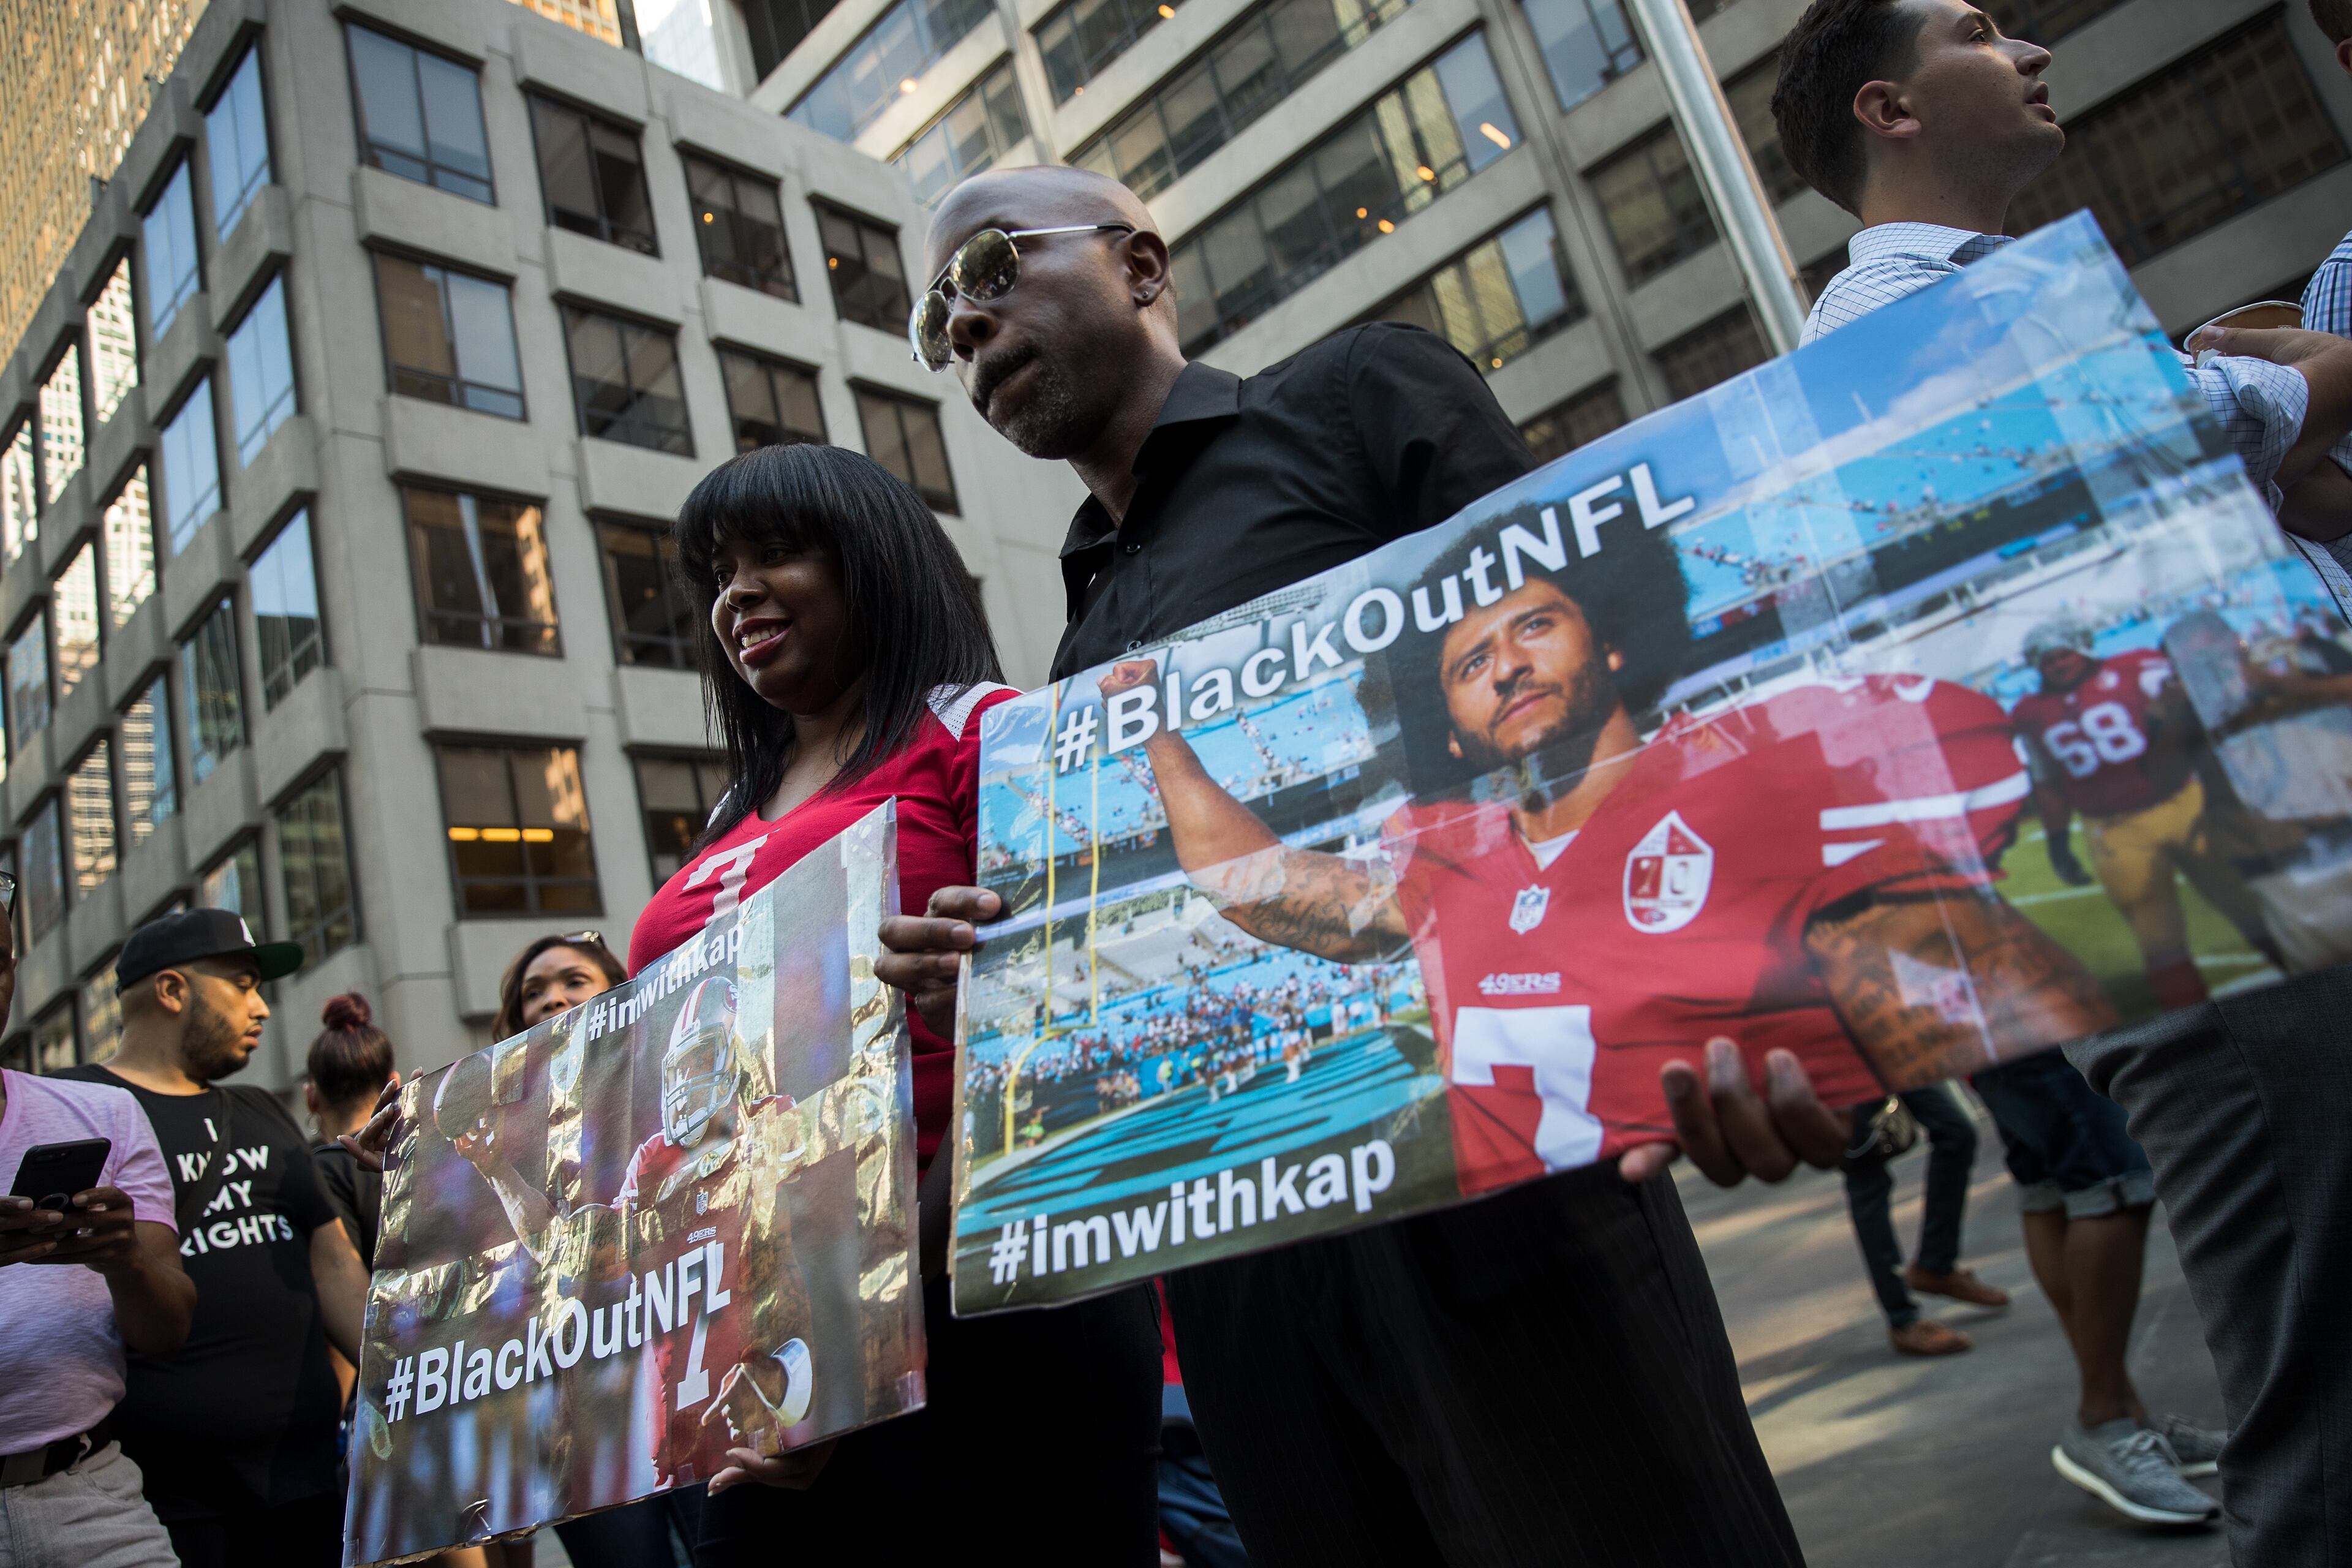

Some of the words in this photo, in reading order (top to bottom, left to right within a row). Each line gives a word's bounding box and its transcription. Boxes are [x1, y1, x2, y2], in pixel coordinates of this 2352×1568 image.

[1054, 462, 1695, 774] #BlackOutNFL
[2043, 701, 2147, 778] 68
[682, 832, 769, 927] 7
[589, 923, 744, 1041] #imwithkap
[1477, 971, 1561, 995] 49ERS
[203, 1118, 219, 1142] I
[1452, 1005, 1605, 1174] 7
[687, 1226, 717, 1244] 49ERS
[989, 1139, 1396, 1285] #imwithkap
[385, 1240, 731, 1423] #BlackOutNFL
